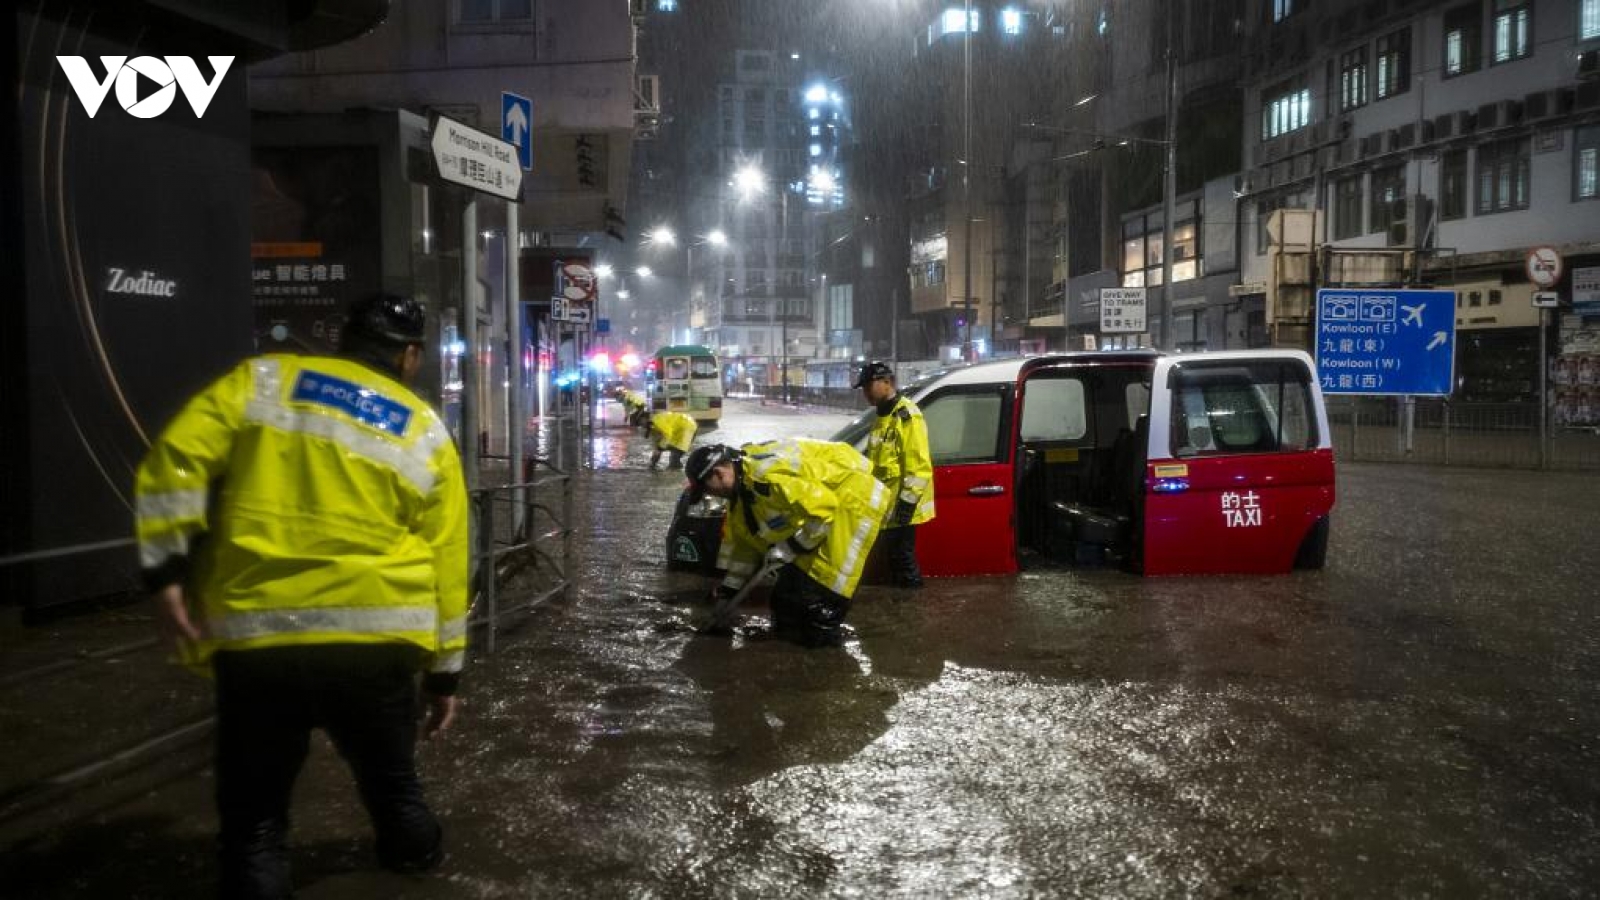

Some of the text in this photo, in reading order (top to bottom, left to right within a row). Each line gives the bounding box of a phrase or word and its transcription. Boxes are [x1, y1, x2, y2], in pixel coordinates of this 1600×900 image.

[449, 127, 510, 163] Morrison Hill Road
[106, 267, 176, 297] Zodiac
[1102, 291, 1122, 299] GIVE
[1124, 291, 1141, 299] WAY
[1322, 323, 1373, 333] Kowloon
[1322, 358, 1372, 368] Kowloon
[320, 384, 386, 419] POLICE
[1221, 490, 1260, 509] 的士
[1221, 508, 1262, 528] TAXI
